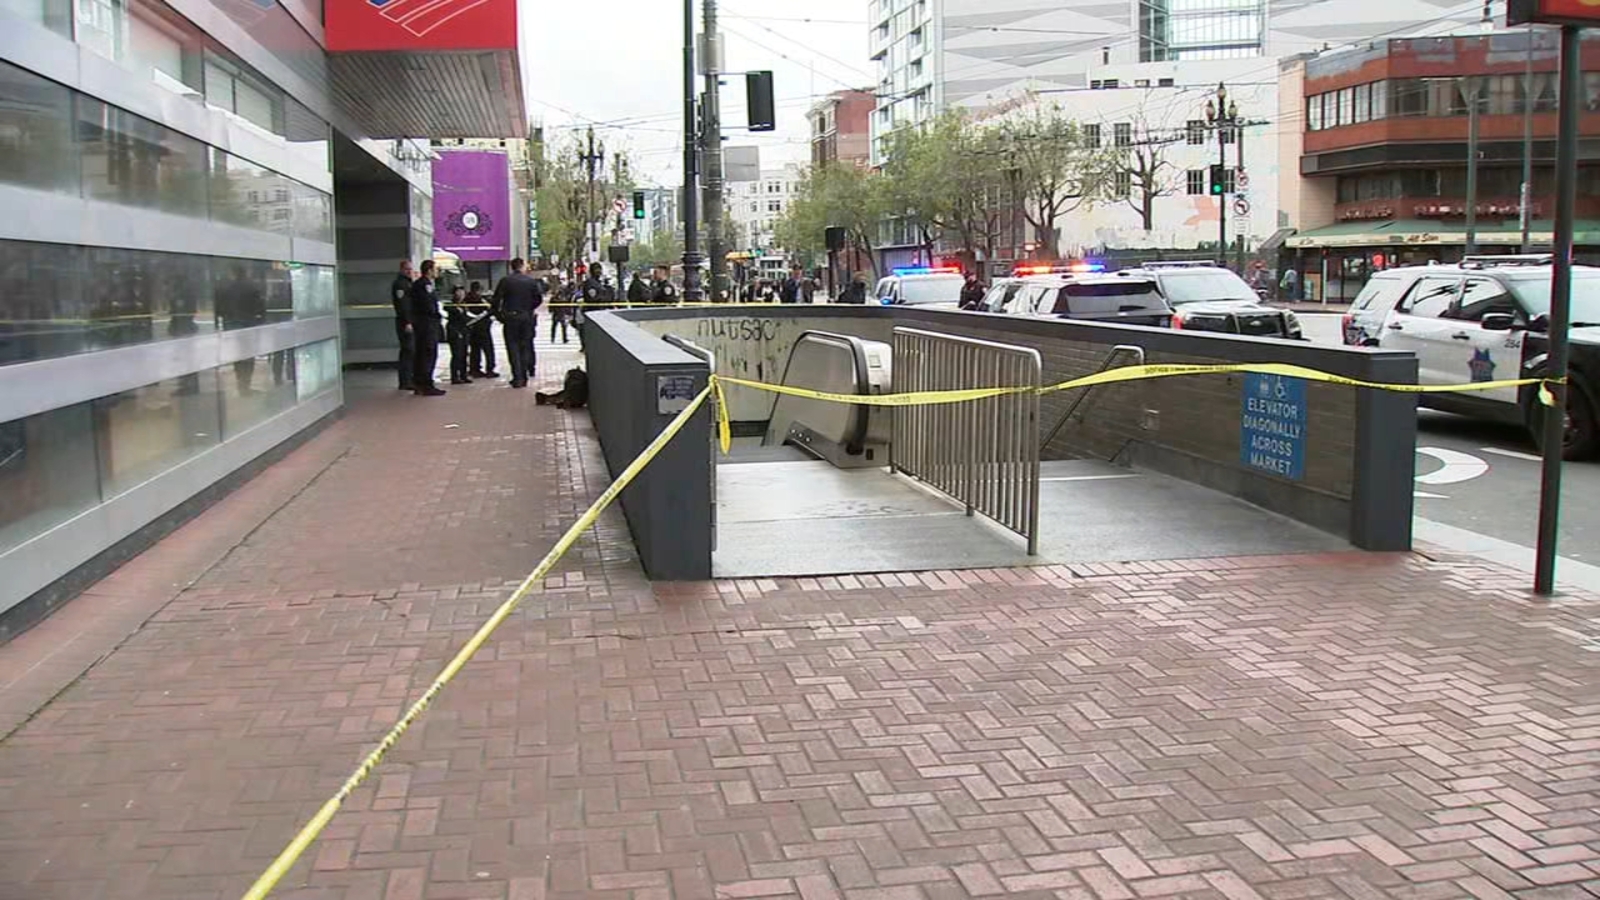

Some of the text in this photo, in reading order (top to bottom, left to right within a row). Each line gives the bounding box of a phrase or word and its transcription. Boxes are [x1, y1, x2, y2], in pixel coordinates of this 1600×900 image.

[529, 200, 539, 248] HOTEL
[1248, 397, 1298, 420] ELEVATOR
[1243, 414, 1301, 440] DIAGONALLY
[1251, 434, 1293, 457] ACROSS
[1250, 452, 1291, 474] MARKET
